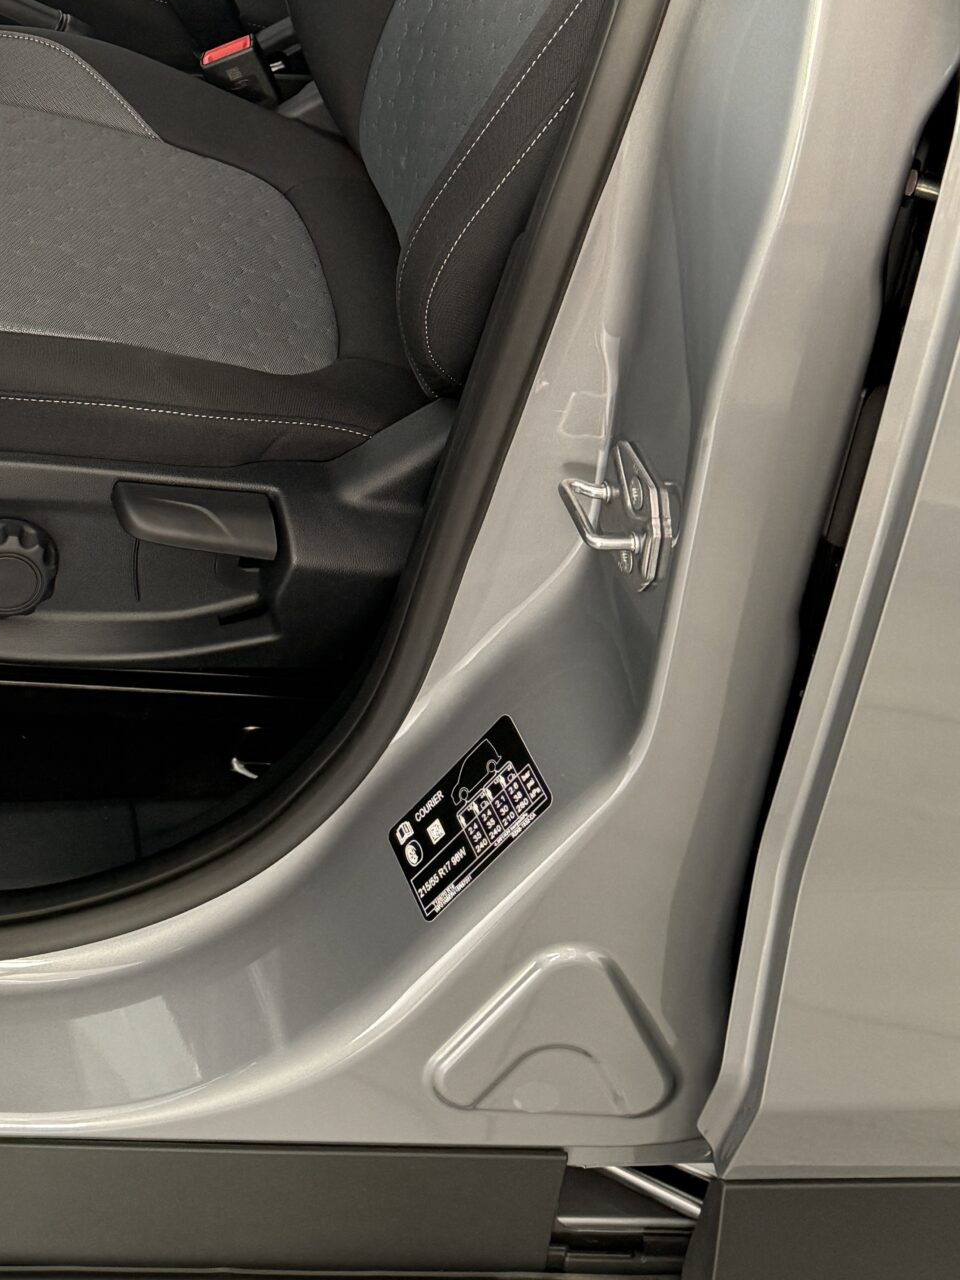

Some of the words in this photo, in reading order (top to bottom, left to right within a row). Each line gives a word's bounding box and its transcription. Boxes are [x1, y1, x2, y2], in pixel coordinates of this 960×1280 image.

[414, 790, 445, 823] COURIER
[468, 822, 478, 835] 2.4
[481, 808, 492, 822] 2.4
[494, 795, 506, 808] 2.1
[507, 781, 519, 795] 2.6
[472, 831, 482, 842] 35
[486, 817, 495, 829] 35
[499, 805, 509, 816] 30
[475, 838, 488, 853] 240
[488, 825, 502, 840] 240
[502, 811, 515, 826] 210
[515, 798, 529, 813] 260
[417, 875, 440, 899] 215/55
[437, 860, 452, 879] R17
